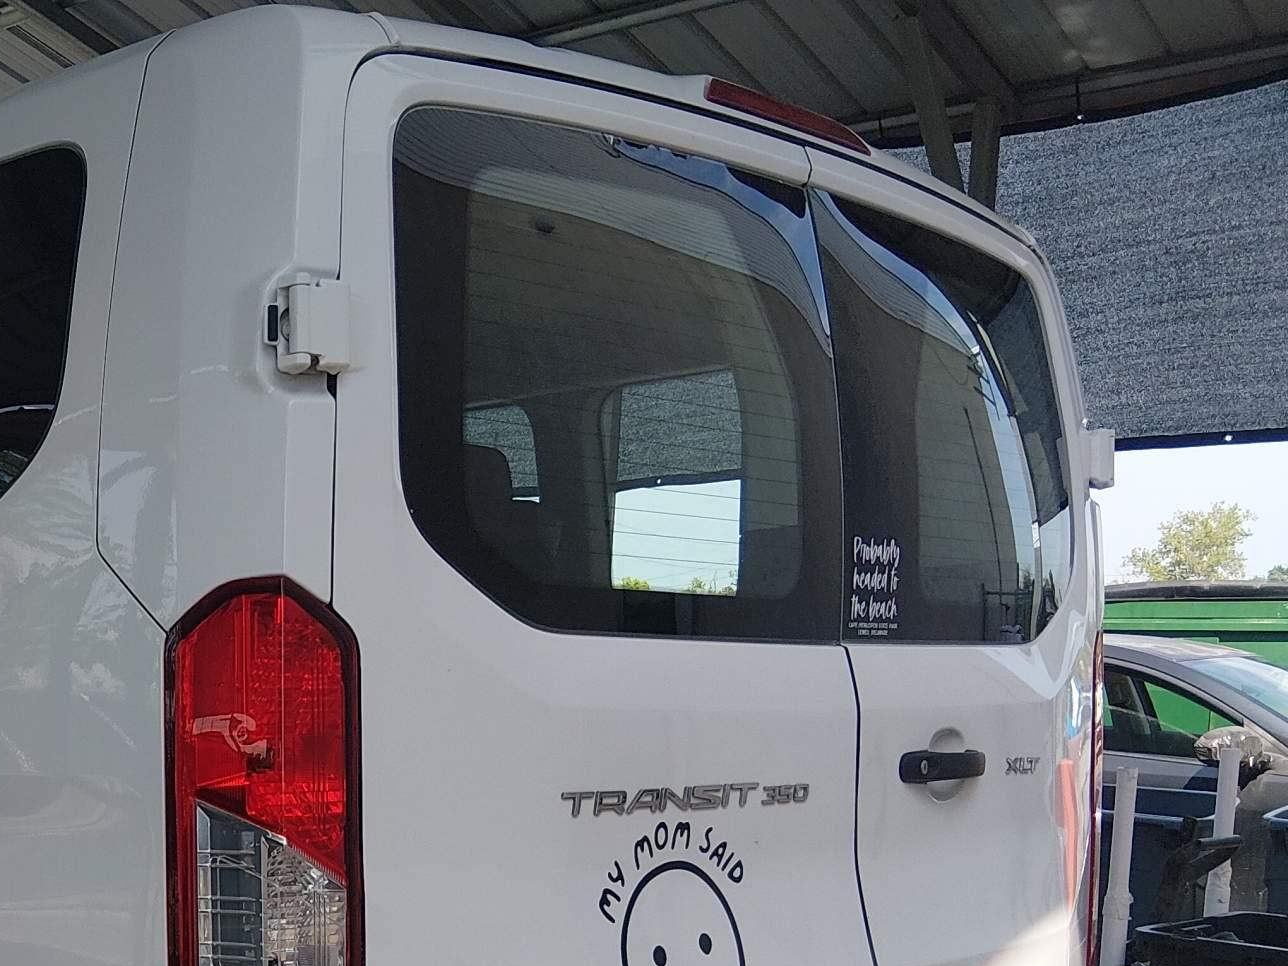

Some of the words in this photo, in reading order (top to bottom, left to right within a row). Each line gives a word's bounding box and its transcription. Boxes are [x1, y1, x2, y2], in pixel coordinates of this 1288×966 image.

[853, 536, 900, 568] Probably
[853, 566, 888, 593] headed
[890, 567, 900, 593] to
[851, 594, 867, 621] the
[869, 595, 898, 622] beach
[1005, 756, 1041, 776] XLT
[561, 782, 759, 818] TRANSIT
[760, 783, 810, 806] 350
[598, 860, 625, 924] MY
[634, 821, 691, 870] MOM
[699, 826, 744, 884] SAID
